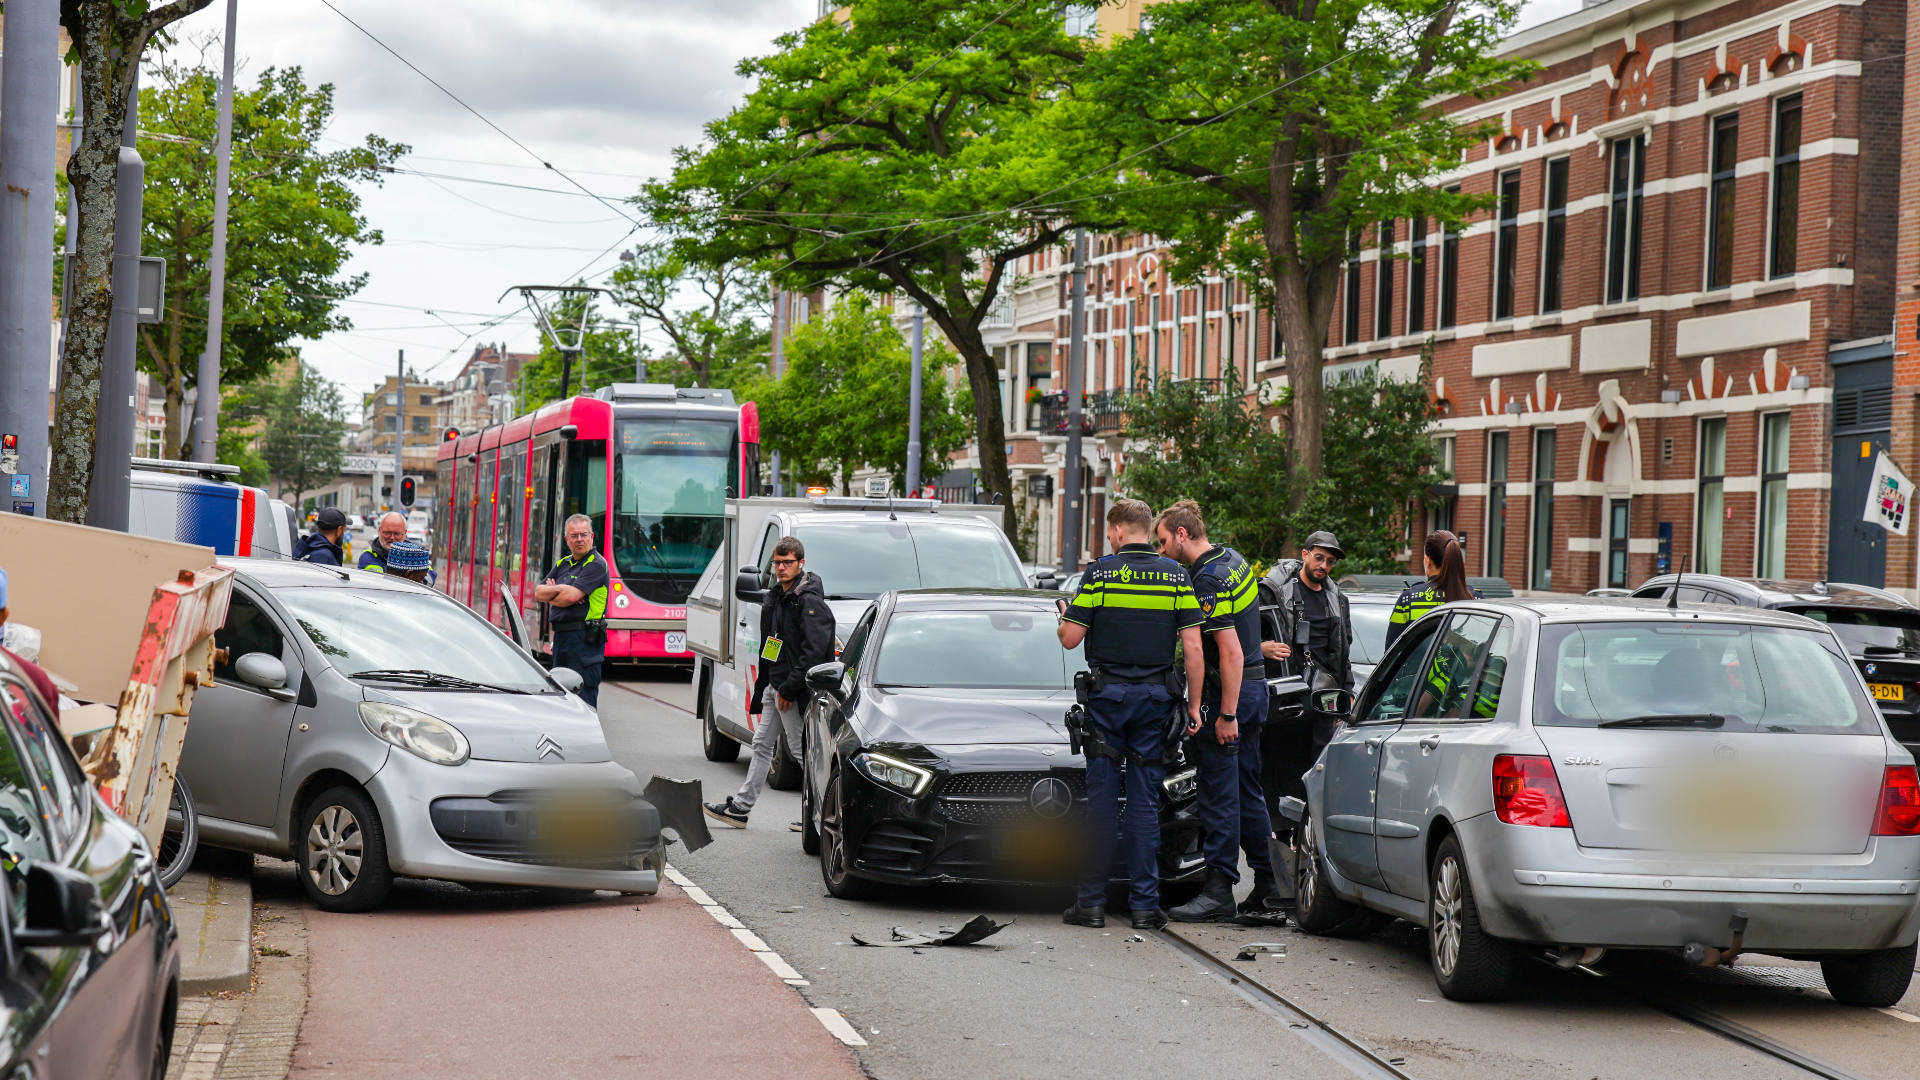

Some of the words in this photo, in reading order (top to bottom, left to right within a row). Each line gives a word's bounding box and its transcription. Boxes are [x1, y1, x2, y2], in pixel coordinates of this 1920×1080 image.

[1112, 565, 1169, 582] POLITIE
[1418, 588, 1446, 601] POLI
[664, 609, 686, 618] 2107
[667, 634, 684, 644] OV
[1563, 756, 1604, 766] Stilo
